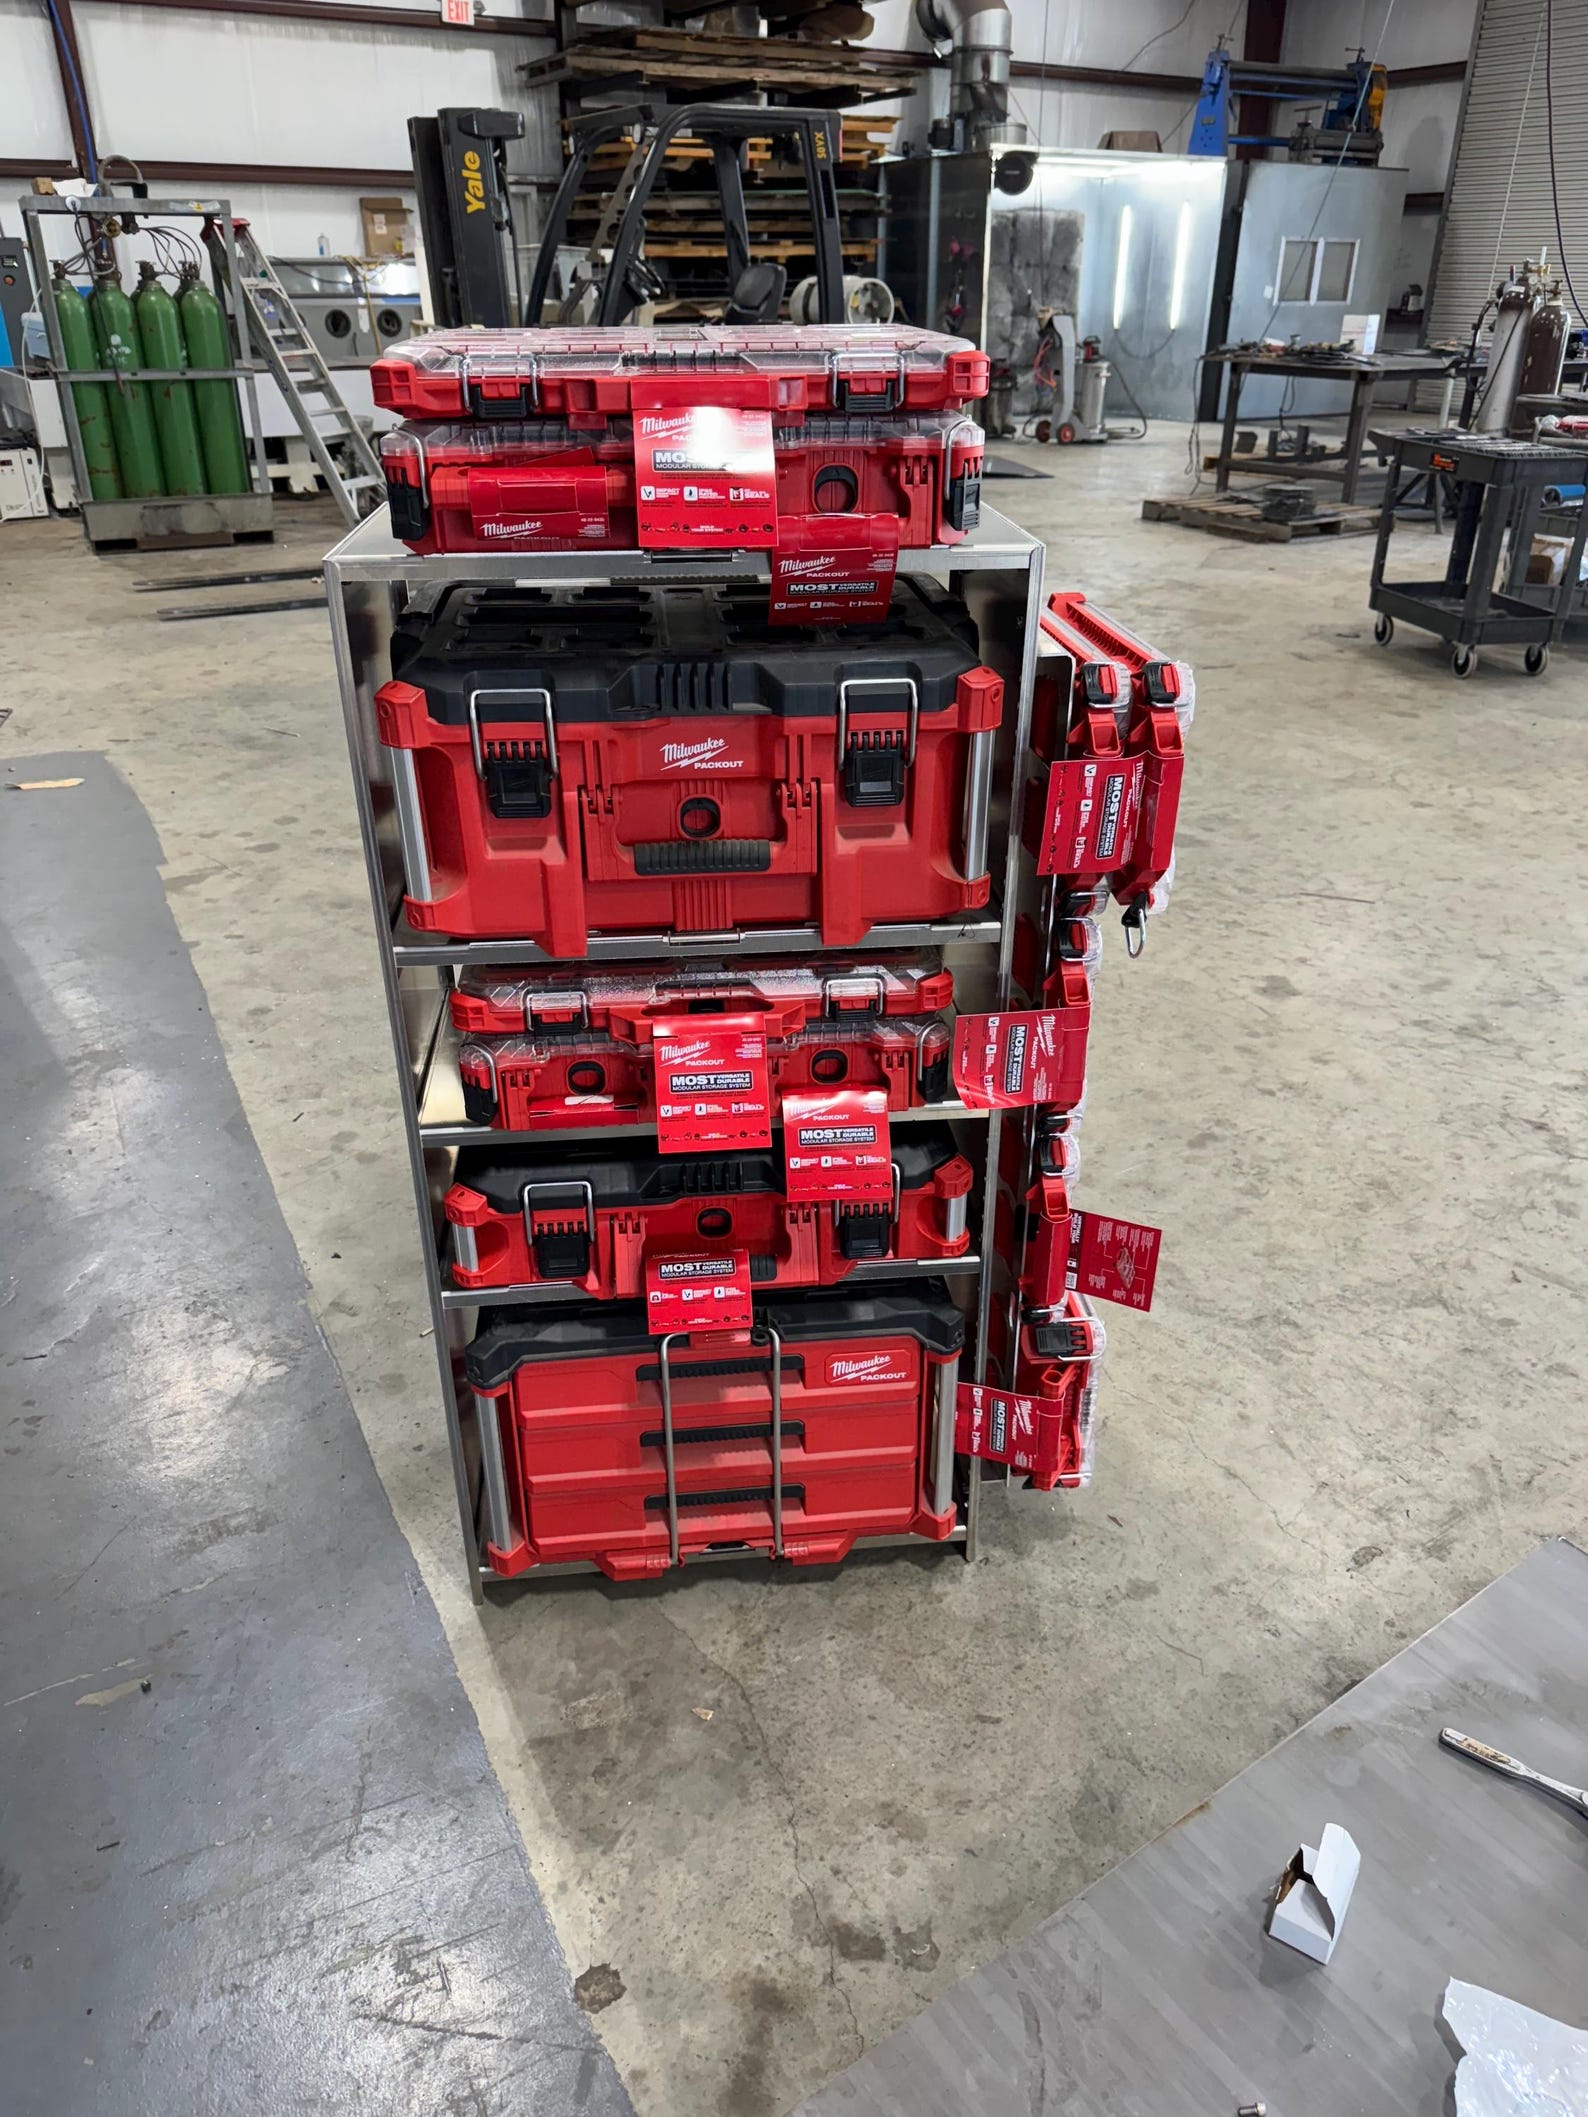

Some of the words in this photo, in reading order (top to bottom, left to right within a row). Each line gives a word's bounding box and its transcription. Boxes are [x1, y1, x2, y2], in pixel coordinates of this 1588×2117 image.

[447, 0, 469, 22] EXIT
[462, 150, 486, 214] Yale
[480, 520, 543, 537] Milwaukee
[778, 556, 836, 574] Milwaukee
[790, 583, 840, 591] MOST
[659, 737, 726, 763] Milwaukee
[694, 760, 744, 769] PACKOUT
[1108, 776, 1123, 822] MOST
[1122, 788, 1133, 829] PACKOUT
[1103, 822, 1112, 856] DURABLE
[1013, 1025, 1026, 1063] MOST
[1041, 1014, 1056, 1056] Milwaukee
[659, 1040, 711, 1061] Milwaukee
[1030, 1036, 1039, 1070] PACKOUT
[685, 1059, 725, 1067] PACKOUT
[672, 1074, 717, 1086] MOST
[801, 1128, 843, 1139] MOST
[661, 1262, 702, 1273] MOST
[830, 1354, 891, 1377] Milwaukee
[860, 1372, 907, 1381] PACKOUT
[997, 1400, 1006, 1429] MOST
[1018, 1399, 1034, 1435] Milwaukee
